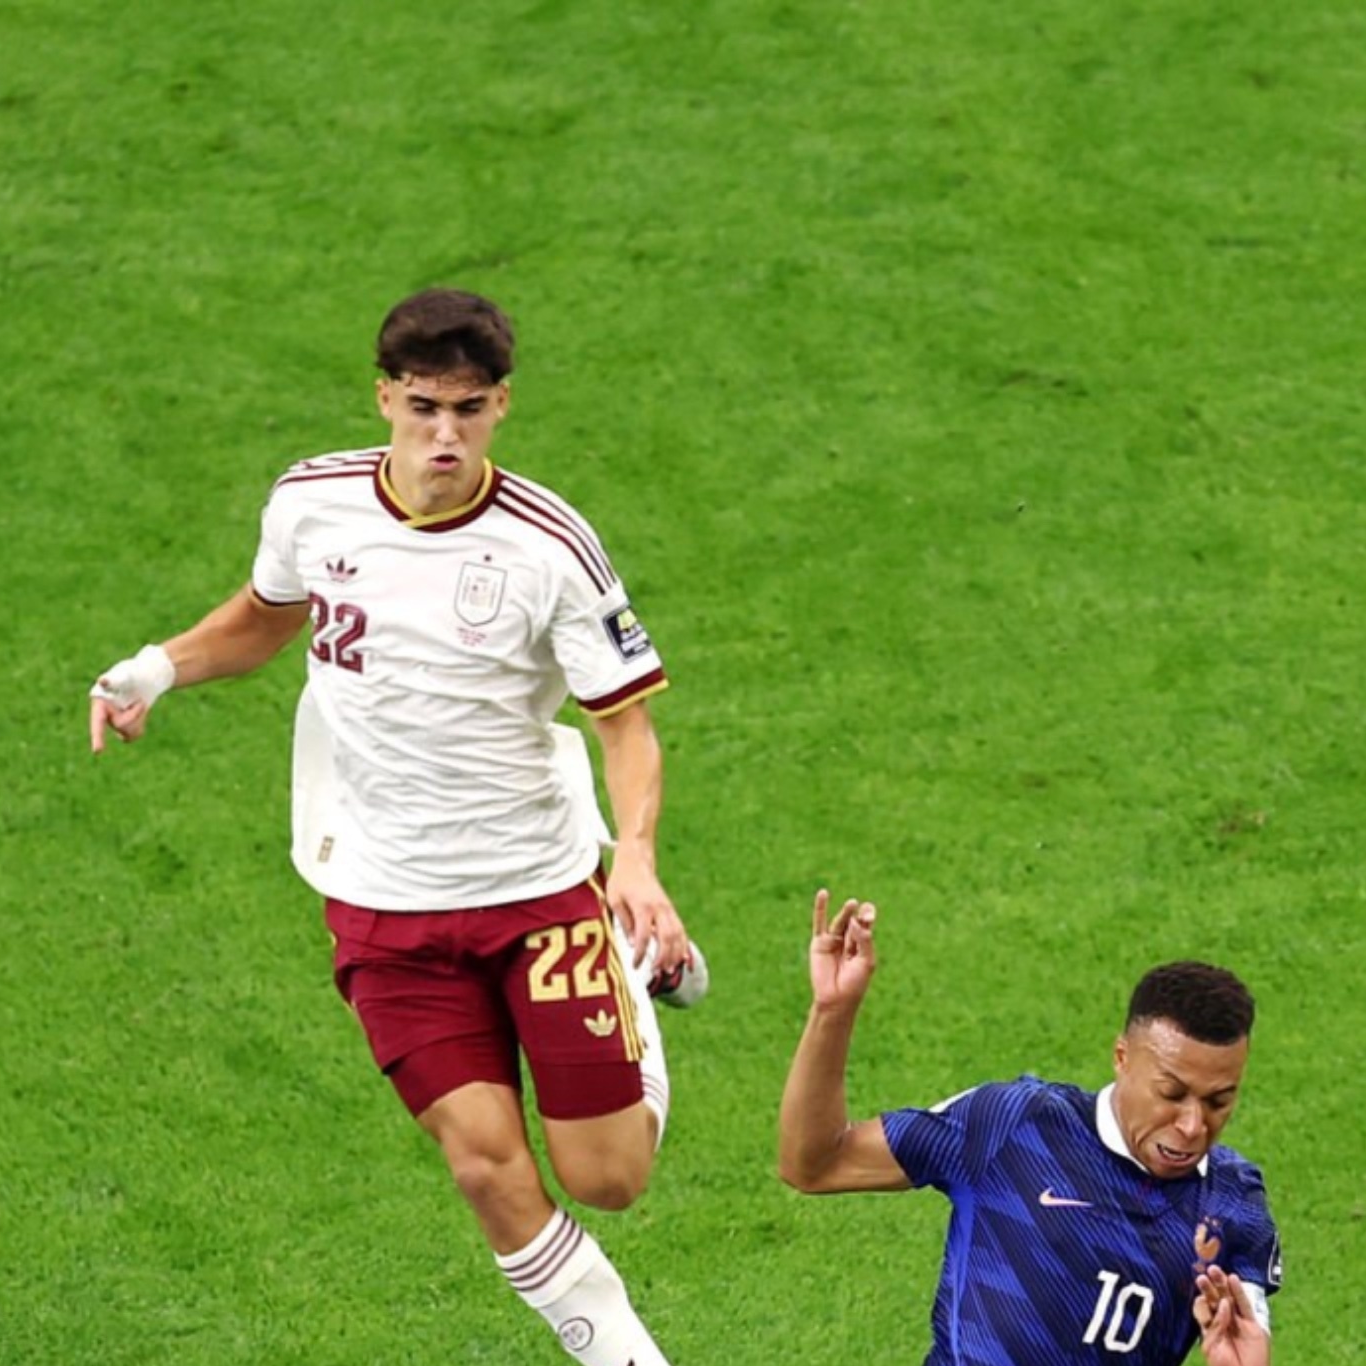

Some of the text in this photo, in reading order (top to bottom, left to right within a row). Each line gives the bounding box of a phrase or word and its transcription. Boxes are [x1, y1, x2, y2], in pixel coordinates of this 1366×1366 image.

[309, 591, 367, 675] 22
[525, 919, 610, 1002] 22
[1081, 1269, 1155, 1353] 10
